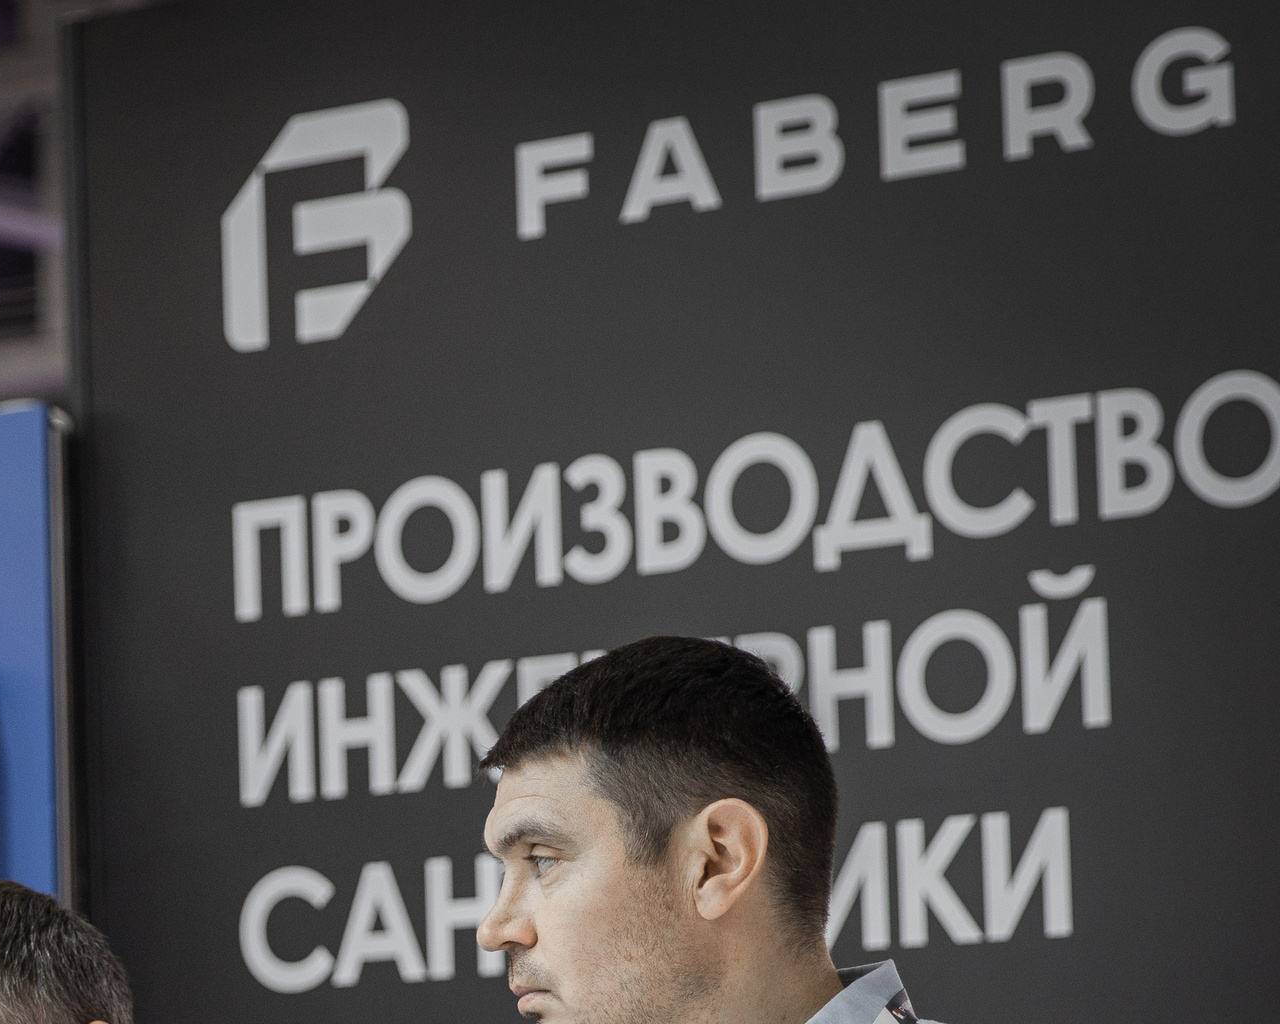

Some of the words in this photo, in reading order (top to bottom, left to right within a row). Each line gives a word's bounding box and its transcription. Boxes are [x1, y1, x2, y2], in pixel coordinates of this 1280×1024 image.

[516, 26, 1236, 240] FABERG
[231, 369, 1280, 623] ПРОИЗВОДСТВО
[237, 564, 1112, 808] ИНЖРНОЙ
[238, 806, 1073, 995] САНИКИ
